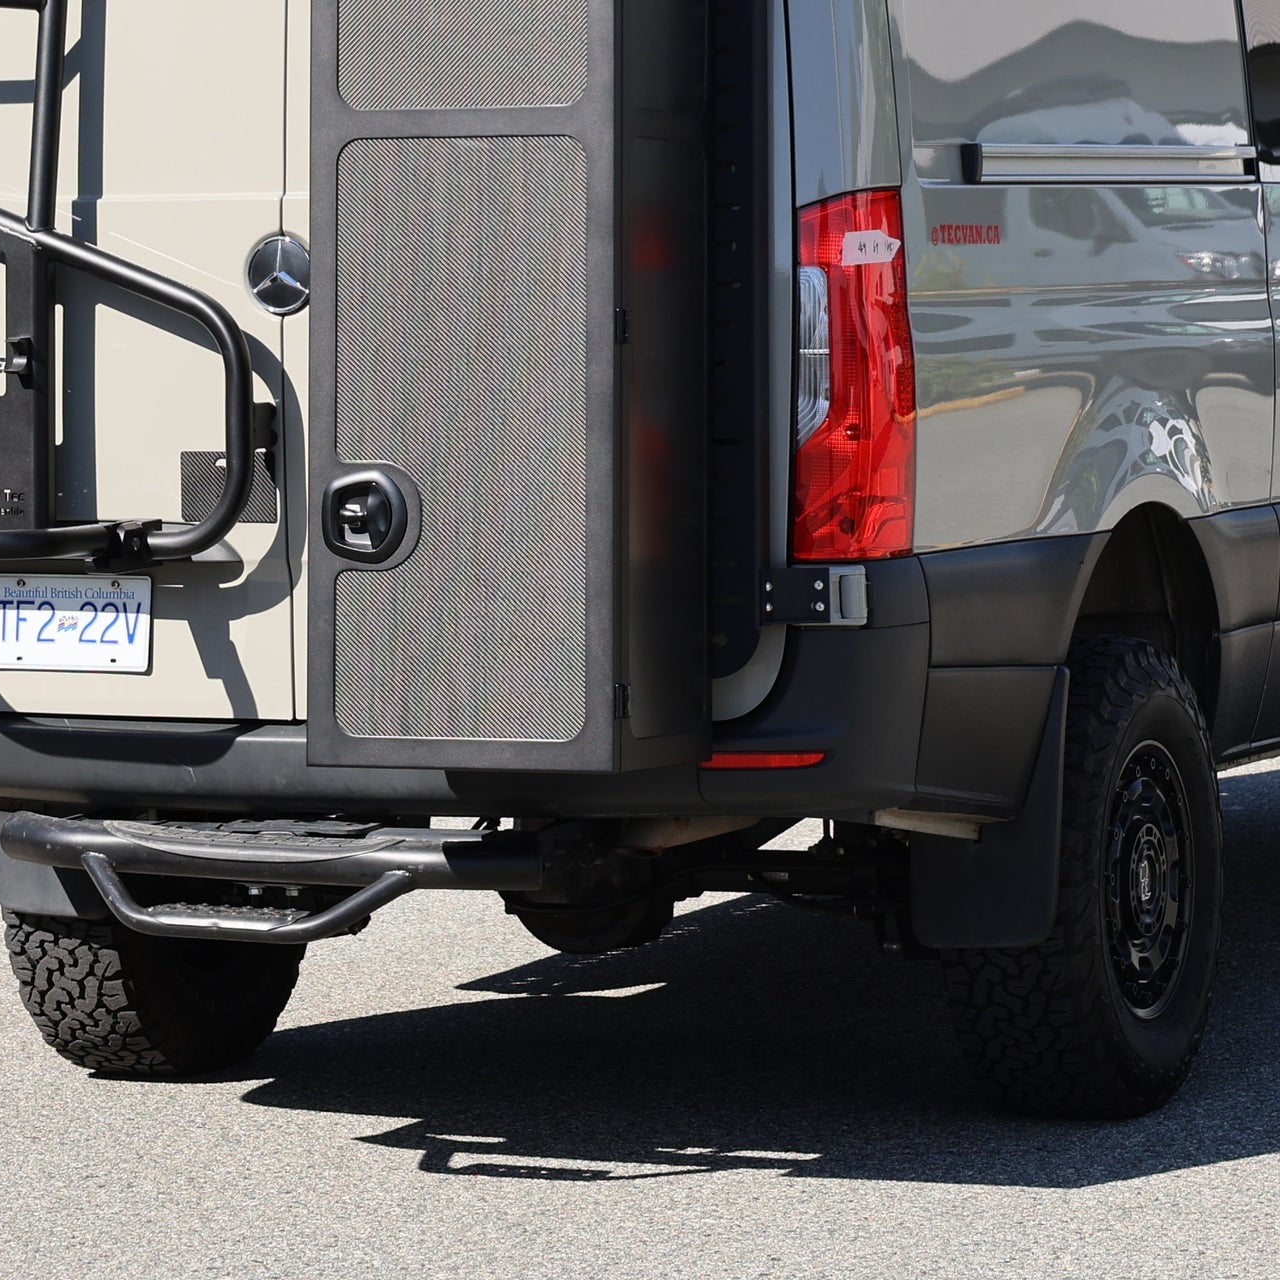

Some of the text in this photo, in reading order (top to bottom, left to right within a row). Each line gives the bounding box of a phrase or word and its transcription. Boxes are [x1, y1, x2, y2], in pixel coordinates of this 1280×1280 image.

[931, 224, 1000, 246] @TECVAN.CA
[4, 586, 135, 600] Beautiful British Columbia
[78, 601, 142, 644] 22V
